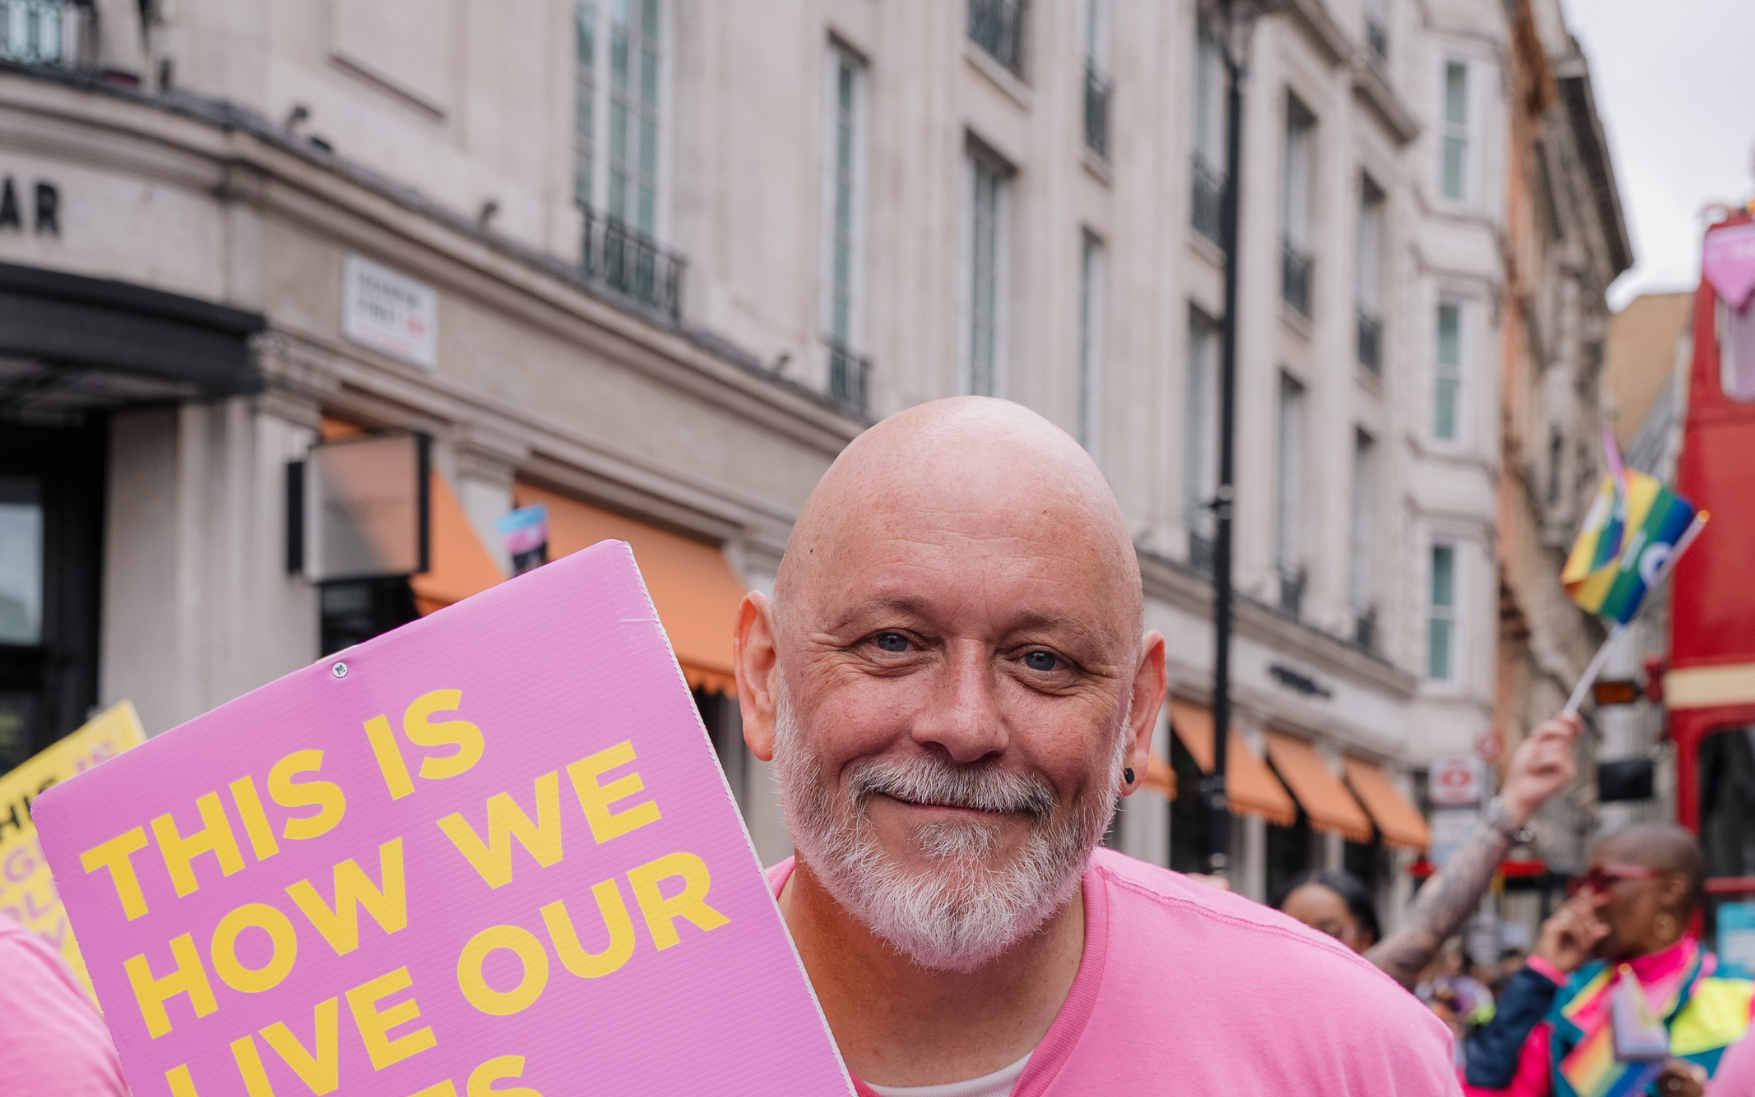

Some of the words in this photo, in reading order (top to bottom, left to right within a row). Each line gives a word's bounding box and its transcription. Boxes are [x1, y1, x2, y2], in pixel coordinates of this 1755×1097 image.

[81, 749, 346, 921] THIS
[363, 688, 484, 800] IS
[124, 837, 407, 1039] HOW
[436, 740, 662, 889] WE
[457, 852, 731, 1016] OUR
